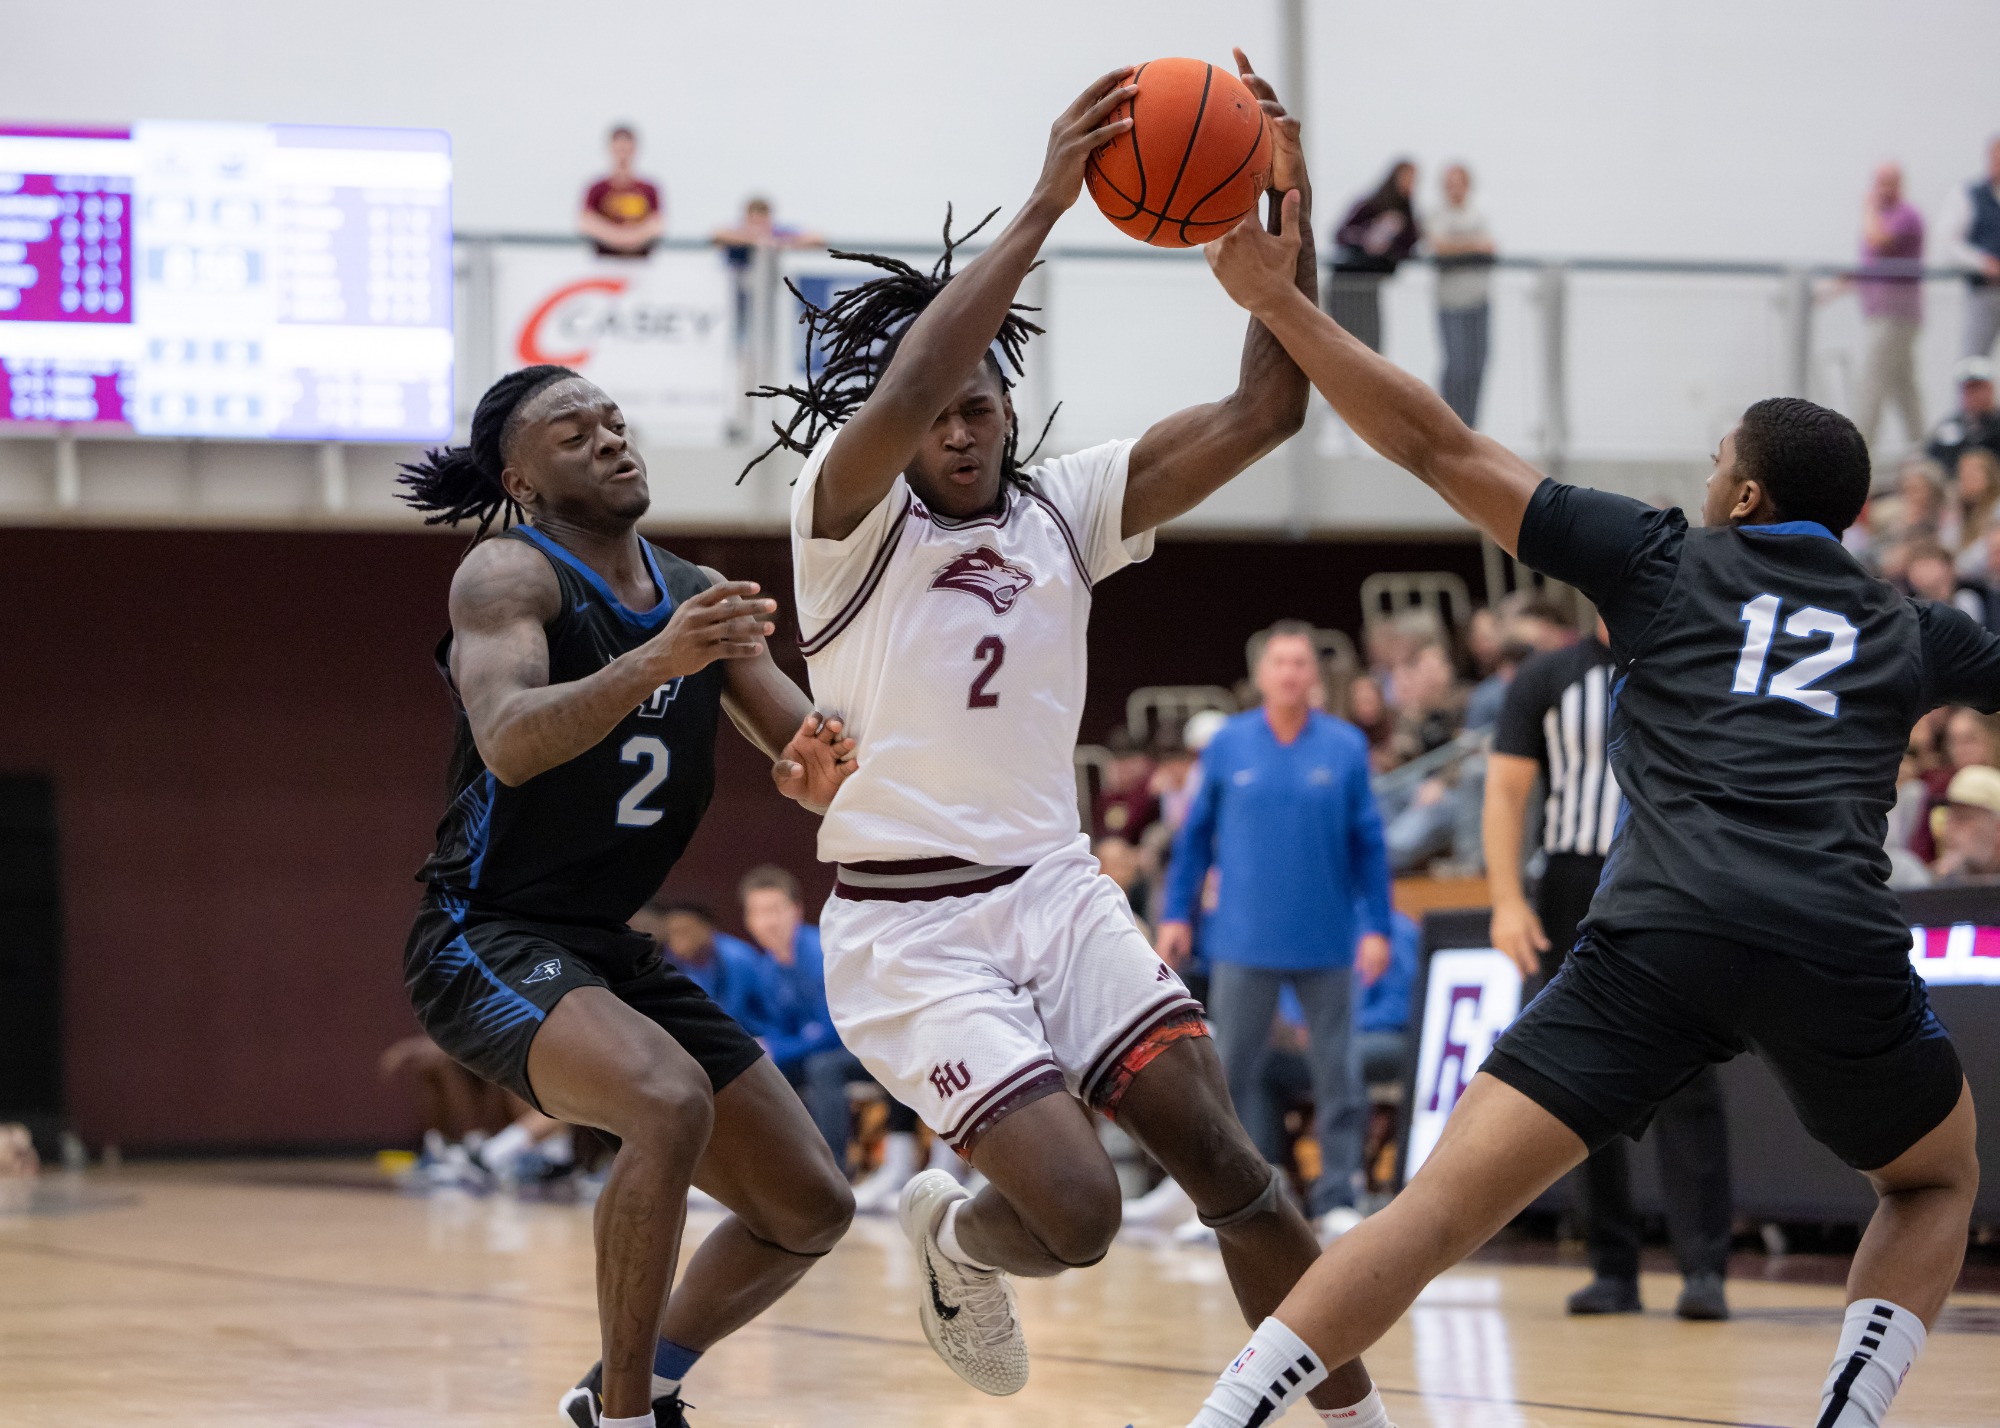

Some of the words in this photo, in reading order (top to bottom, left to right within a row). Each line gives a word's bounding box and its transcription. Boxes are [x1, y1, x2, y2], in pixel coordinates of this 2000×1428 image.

[966, 634, 1006, 710] 2
[1730, 592, 1860, 718] 12
[615, 734, 671, 828] 2
